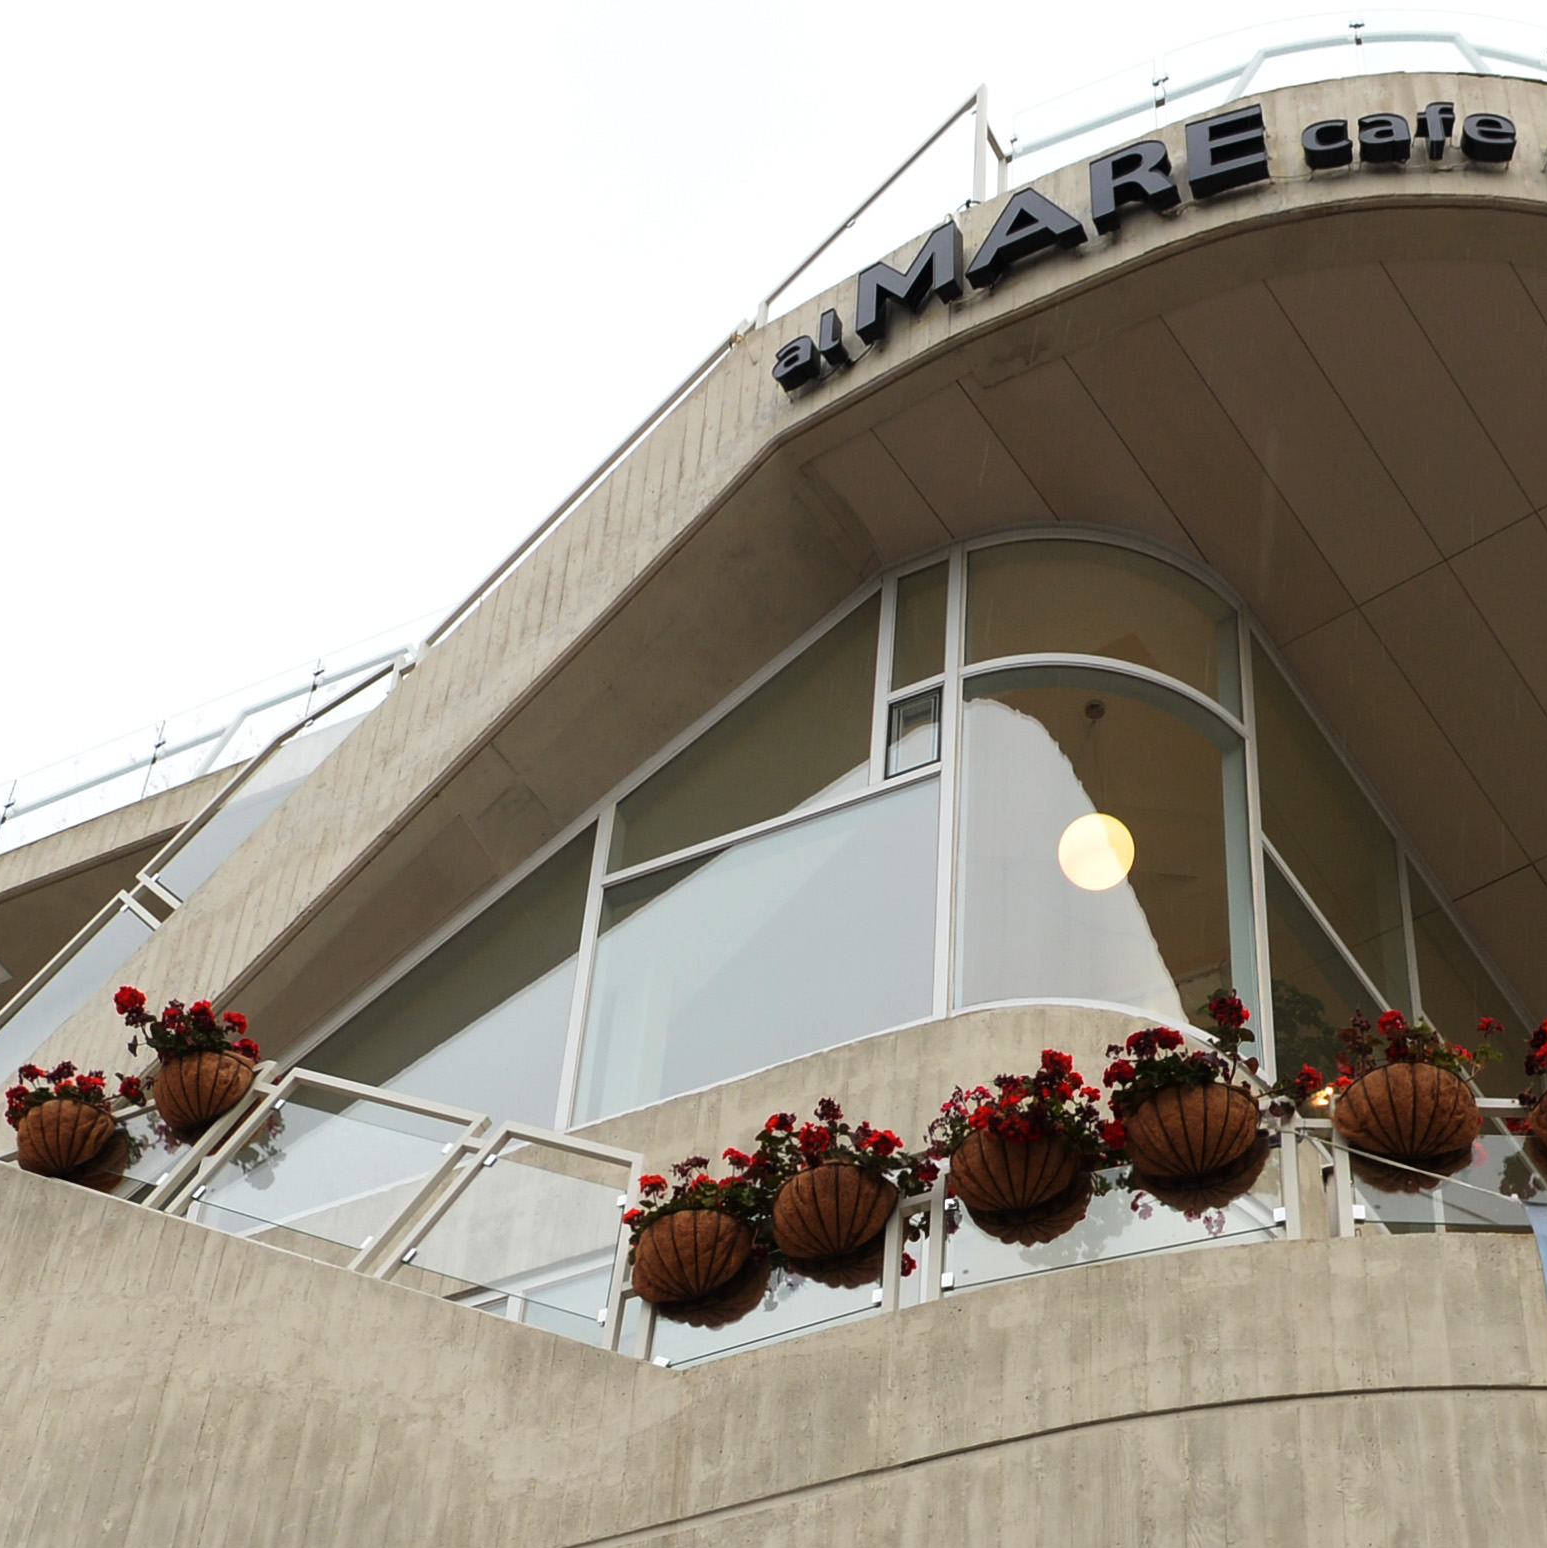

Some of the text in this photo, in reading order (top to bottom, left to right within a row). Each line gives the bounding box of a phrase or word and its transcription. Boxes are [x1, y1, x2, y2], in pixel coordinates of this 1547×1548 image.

[771, 307, 849, 392] al
[854, 102, 1270, 346] MARE
[1300, 101, 1518, 170] cafe
